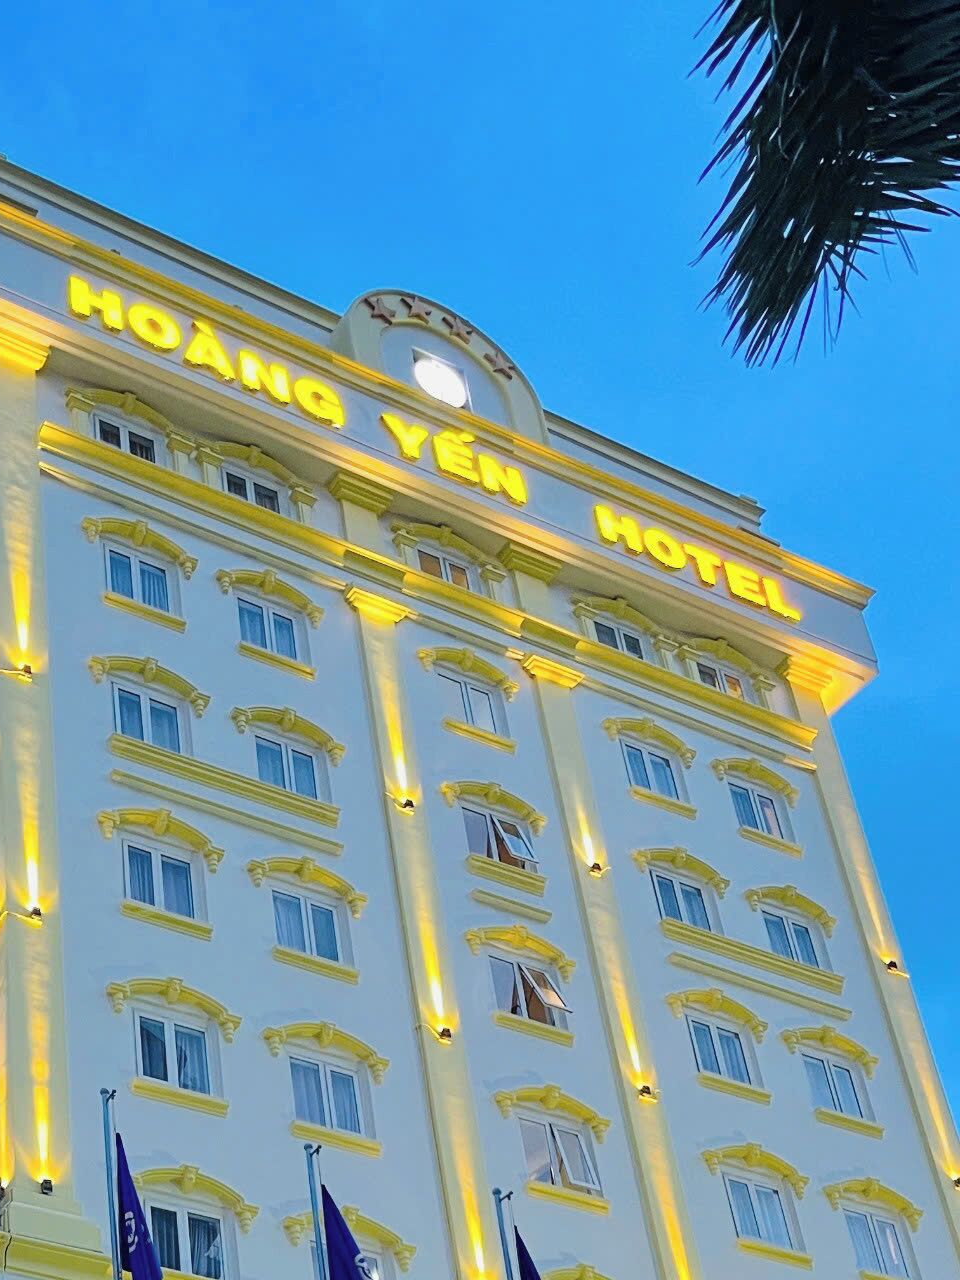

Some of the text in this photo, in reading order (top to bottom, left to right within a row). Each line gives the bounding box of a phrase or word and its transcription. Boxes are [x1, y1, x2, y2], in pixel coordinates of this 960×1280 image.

[69, 275, 802, 622] HOÀNG YẾN HOTEL
